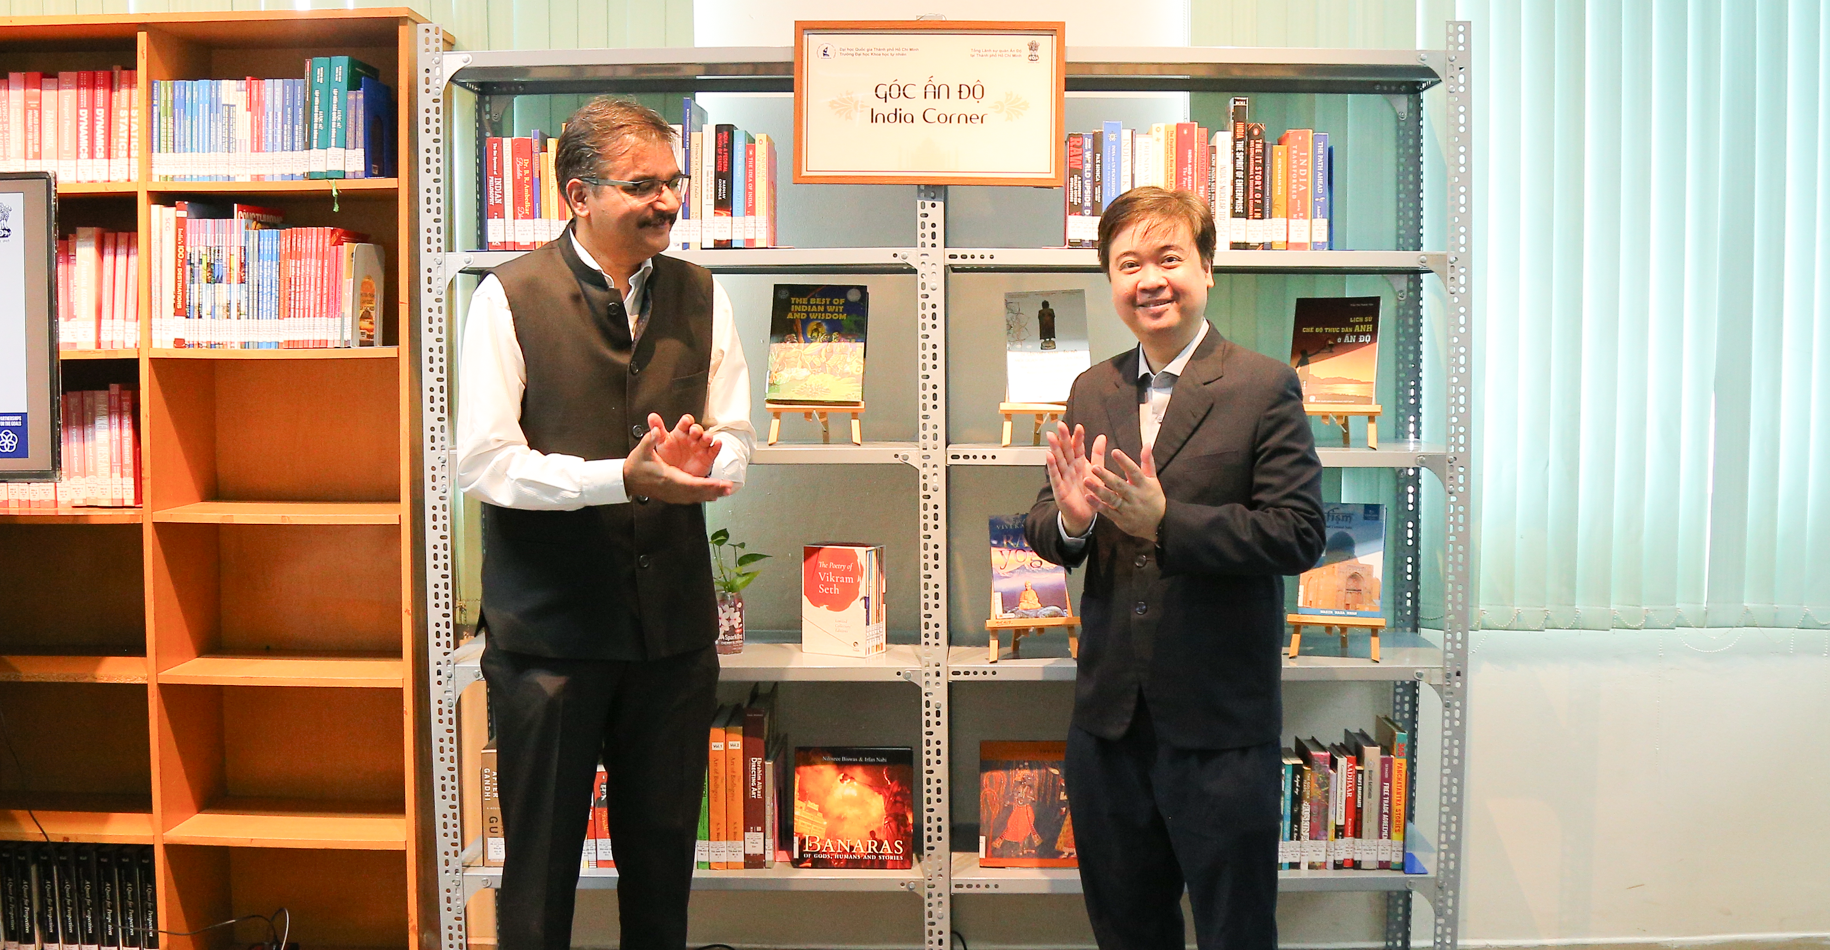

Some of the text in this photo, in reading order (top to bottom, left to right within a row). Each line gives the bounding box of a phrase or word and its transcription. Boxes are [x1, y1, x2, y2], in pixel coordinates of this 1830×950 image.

[875, 76, 984, 103] GÓC ẤN ĐỘ
[870, 108, 988, 124] India Corner
[79, 109, 88, 159] DYNAMICS
[96, 108, 104, 158] DYNAMICS
[118, 110, 127, 157] STATICS
[130, 109, 138, 157] STATICS
[1070, 137, 1083, 169] RAW
[1235, 122, 1244, 213] INDIA THE SPIRIT OF ENTERPRISE
[1299, 152, 1307, 191] INDIA
[1254, 193, 1261, 203] OF
[1344, 333, 1356, 342] ẤN
[1359, 333, 1371, 344] ĐỘ
[818, 572, 854, 584] Vikram
[829, 562, 846, 572] Poetry
[847, 562, 853, 571] of
[818, 584, 840, 594] Seth
[803, 835, 904, 854] BANARAS
